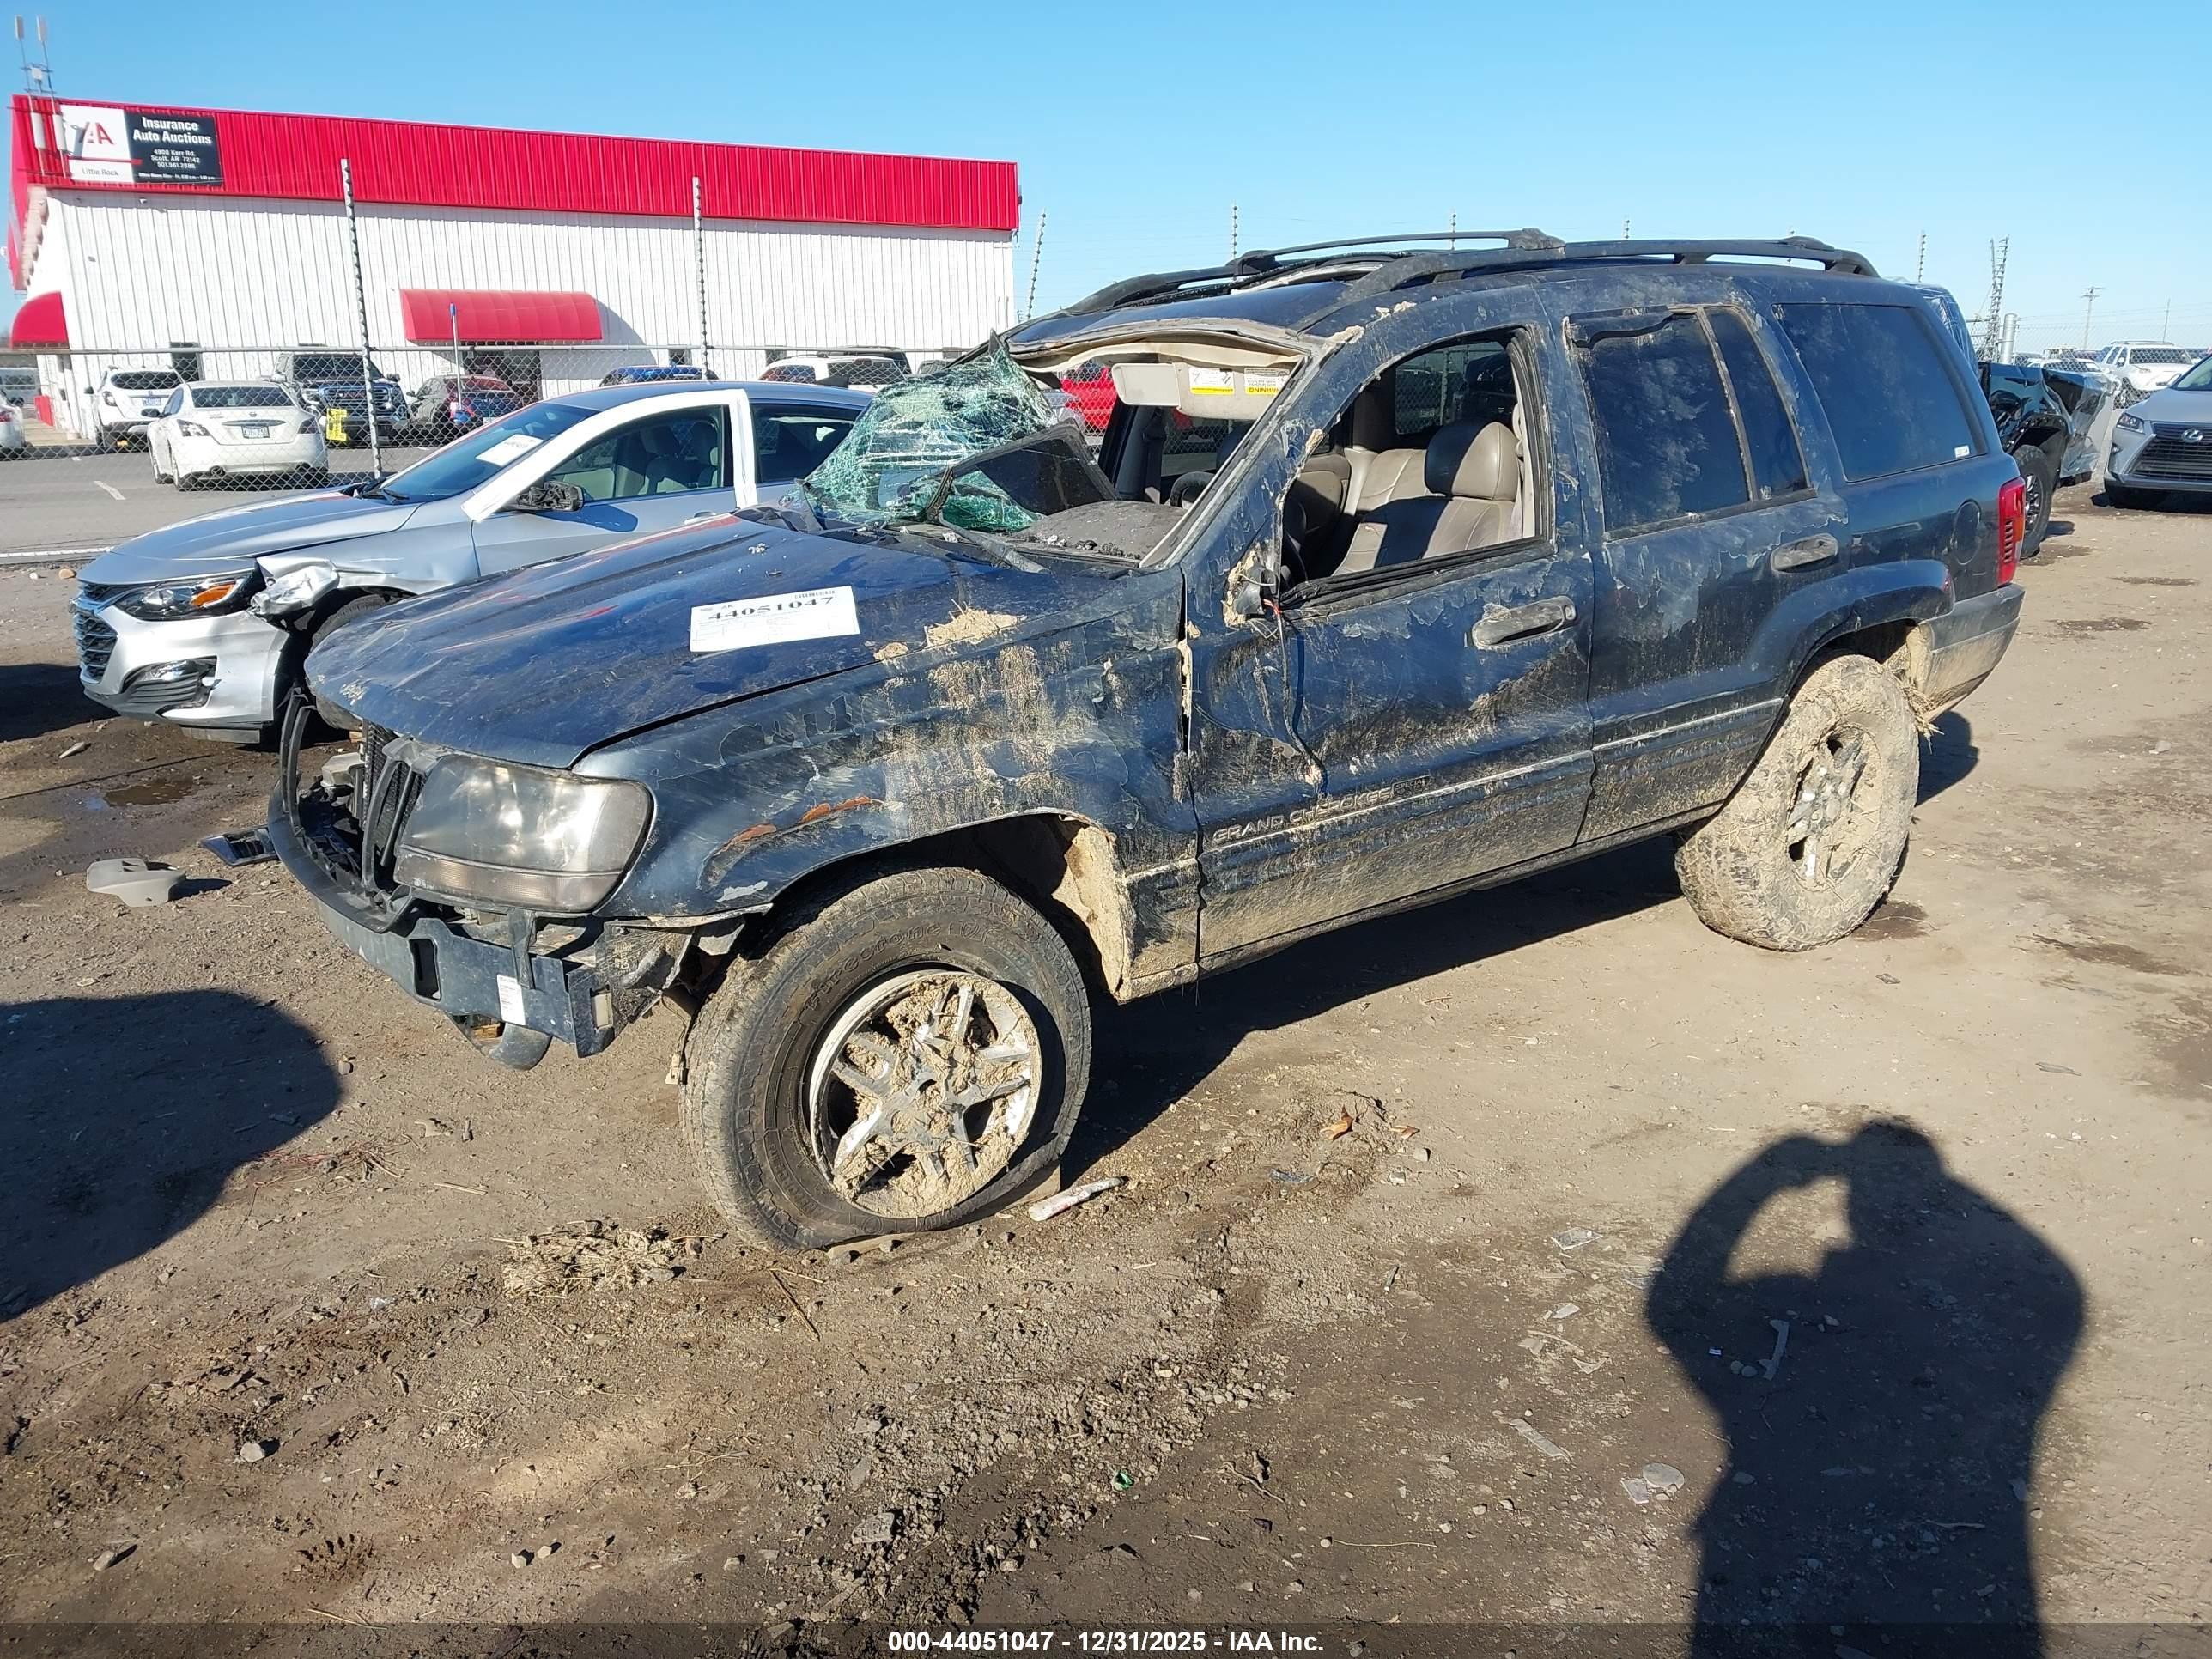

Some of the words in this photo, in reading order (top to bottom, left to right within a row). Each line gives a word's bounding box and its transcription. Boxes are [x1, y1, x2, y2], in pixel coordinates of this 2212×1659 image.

[142, 117, 199, 131] Insurance
[133, 129, 160, 141] Auto
[162, 131, 212, 144] Auctions
[708, 596, 834, 620] 44051047
[1213, 816, 1284, 843] GRAND
[1289, 787, 1393, 823] CHEROKEE
